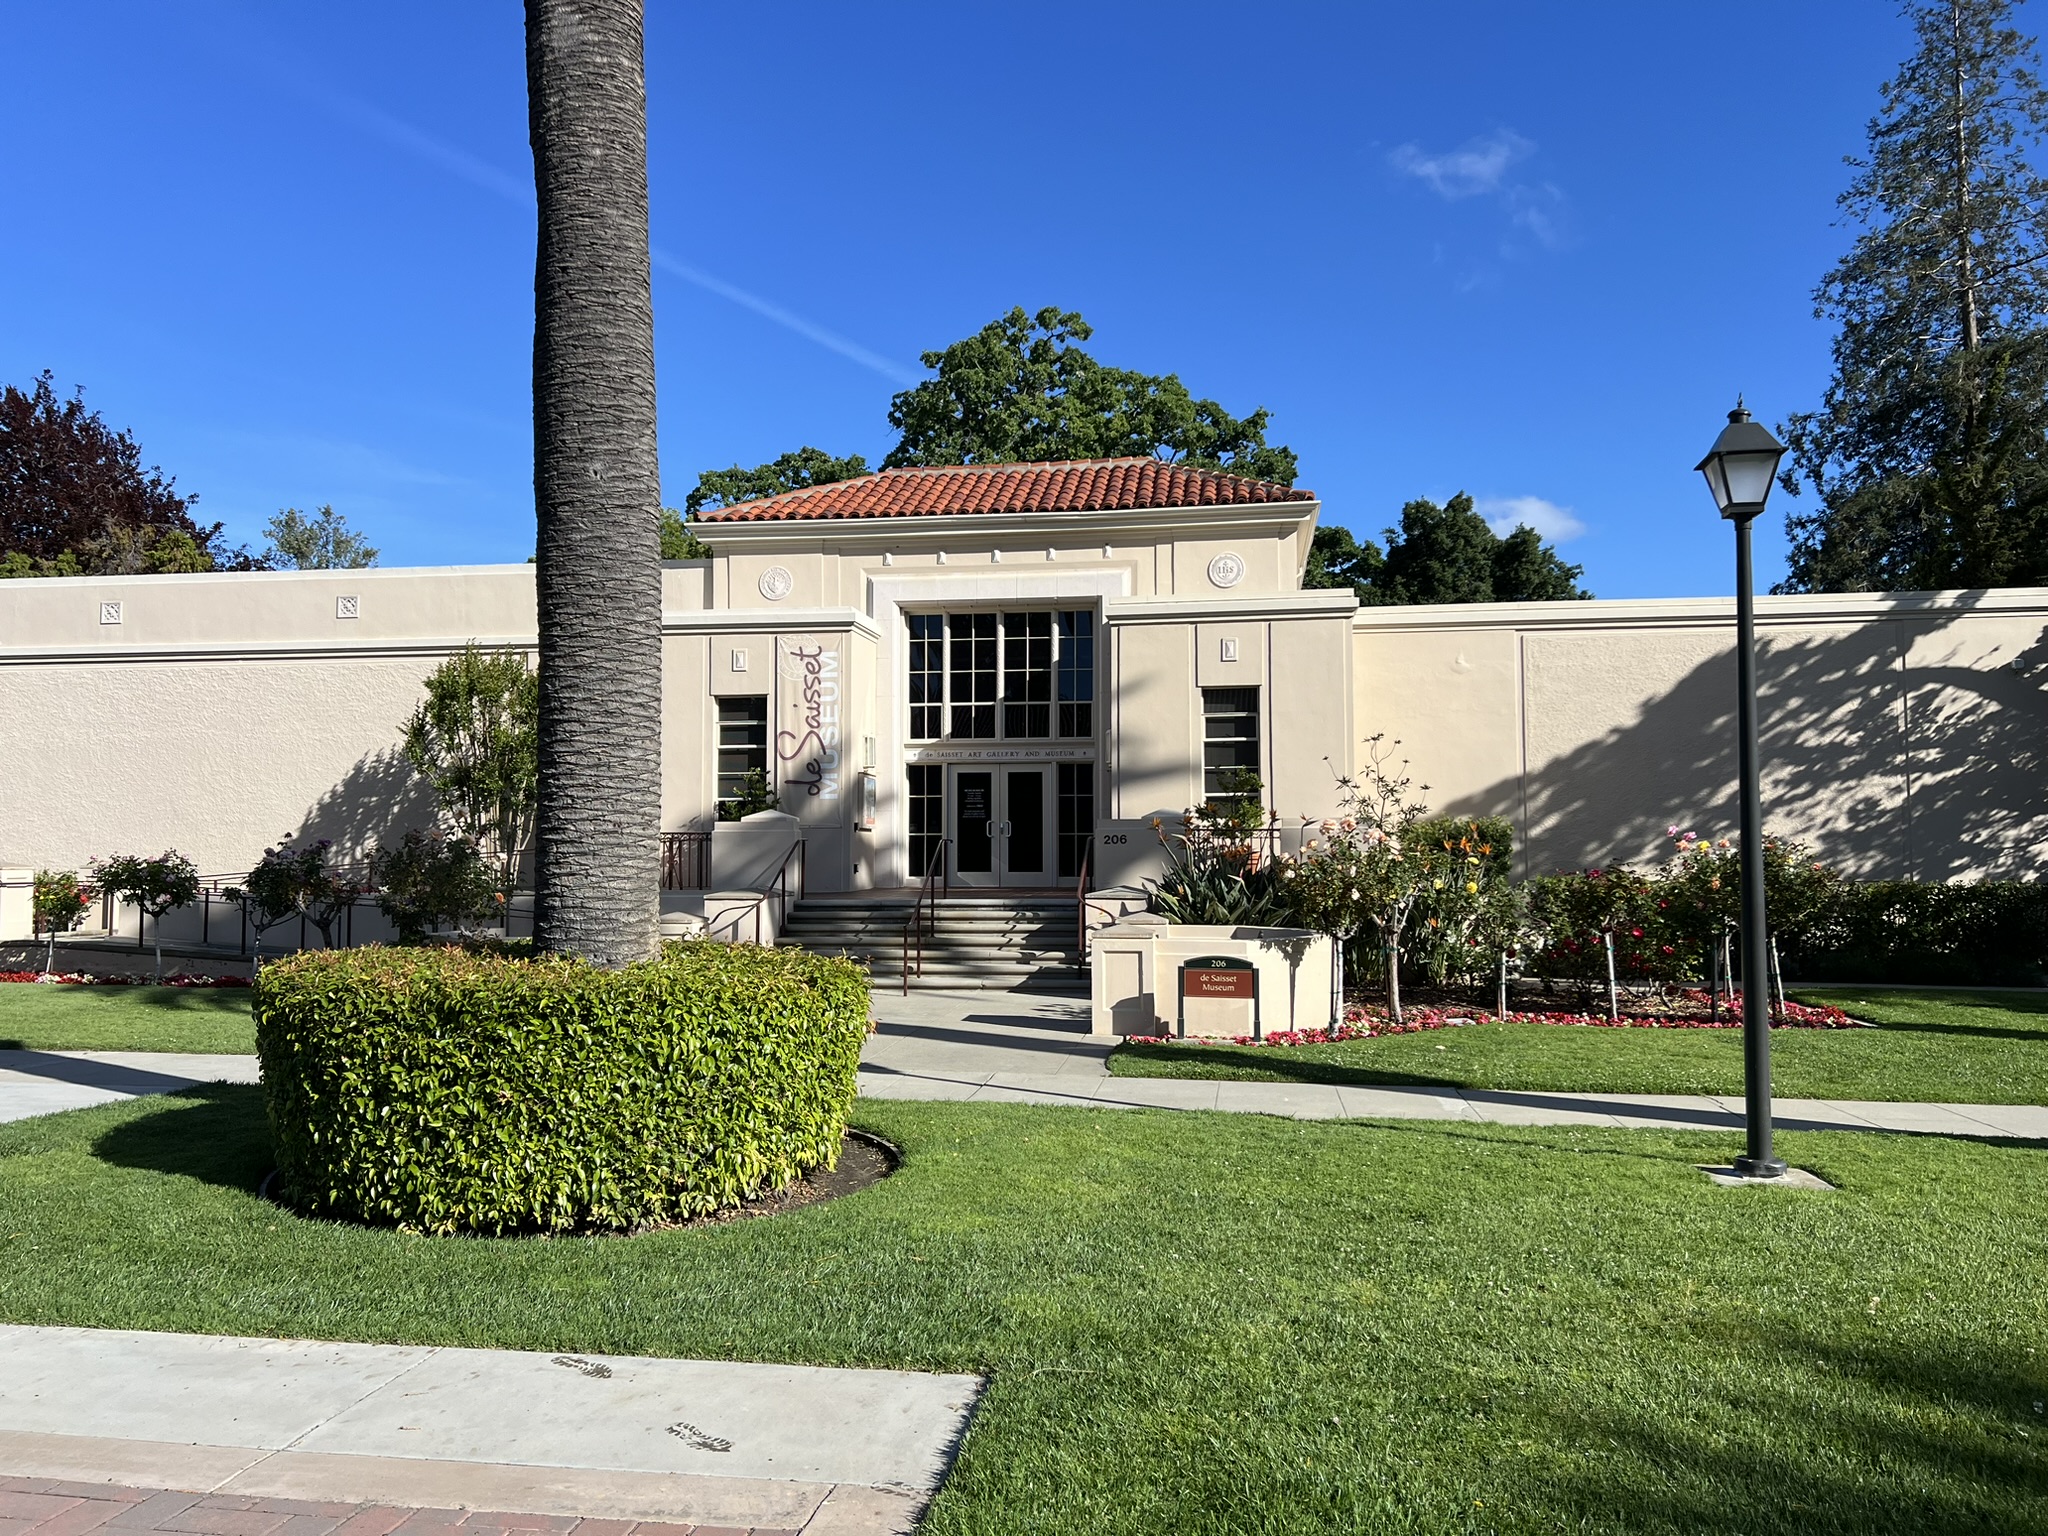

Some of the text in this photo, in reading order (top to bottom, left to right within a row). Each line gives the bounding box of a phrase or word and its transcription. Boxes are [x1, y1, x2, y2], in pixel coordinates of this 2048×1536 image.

[778, 645, 826, 760] Saisset
[820, 651, 839, 800] MUSEUM
[784, 758, 822, 796] de
[1103, 834, 1128, 845] 206
[1200, 974, 1237, 982] de Saisset
[1202, 983, 1235, 991] Museum
